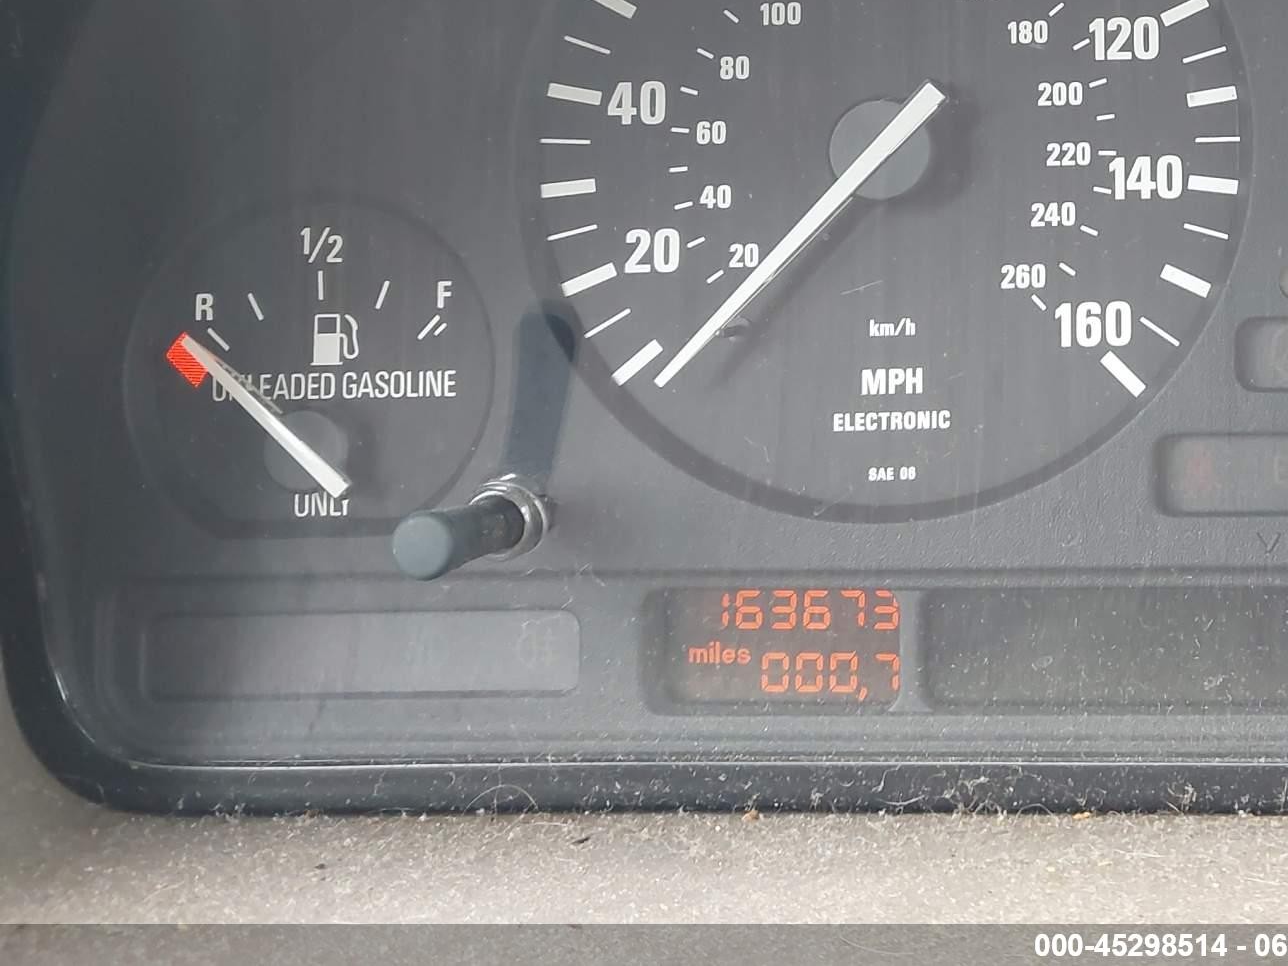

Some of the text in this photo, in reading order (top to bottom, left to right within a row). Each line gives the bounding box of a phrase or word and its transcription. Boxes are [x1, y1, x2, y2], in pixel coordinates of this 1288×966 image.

[759, 2, 802, 27] 100
[1007, 20, 1048, 45] 180
[1088, 16, 1160, 60] 120
[719, 56, 750, 80] 80
[607, 81, 666, 125] 40
[1037, 82, 1083, 106] 200
[696, 122, 727, 145] 60
[1045, 142, 1092, 167] 220
[1109, 155, 1183, 200] 140
[700, 186, 732, 209] 40
[1030, 203, 1077, 227] 240
[300, 227, 344, 263] 1/2
[624, 229, 680, 274] 20
[729, 243, 759, 268] 20
[1000, 264, 1046, 289] 260
[436, 280, 453, 308] F
[195, 293, 214, 321] R
[869, 318, 916, 337] km/h
[1054, 300, 1133, 347] 160
[342, 370, 457, 399] GASOLINE
[860, 367, 923, 395] MPH
[832, 410, 951, 432] ELECTRONIC
[868, 466, 894, 481] SAE
[721, 589, 900, 630] 163673
[688, 641, 751, 664] miles
